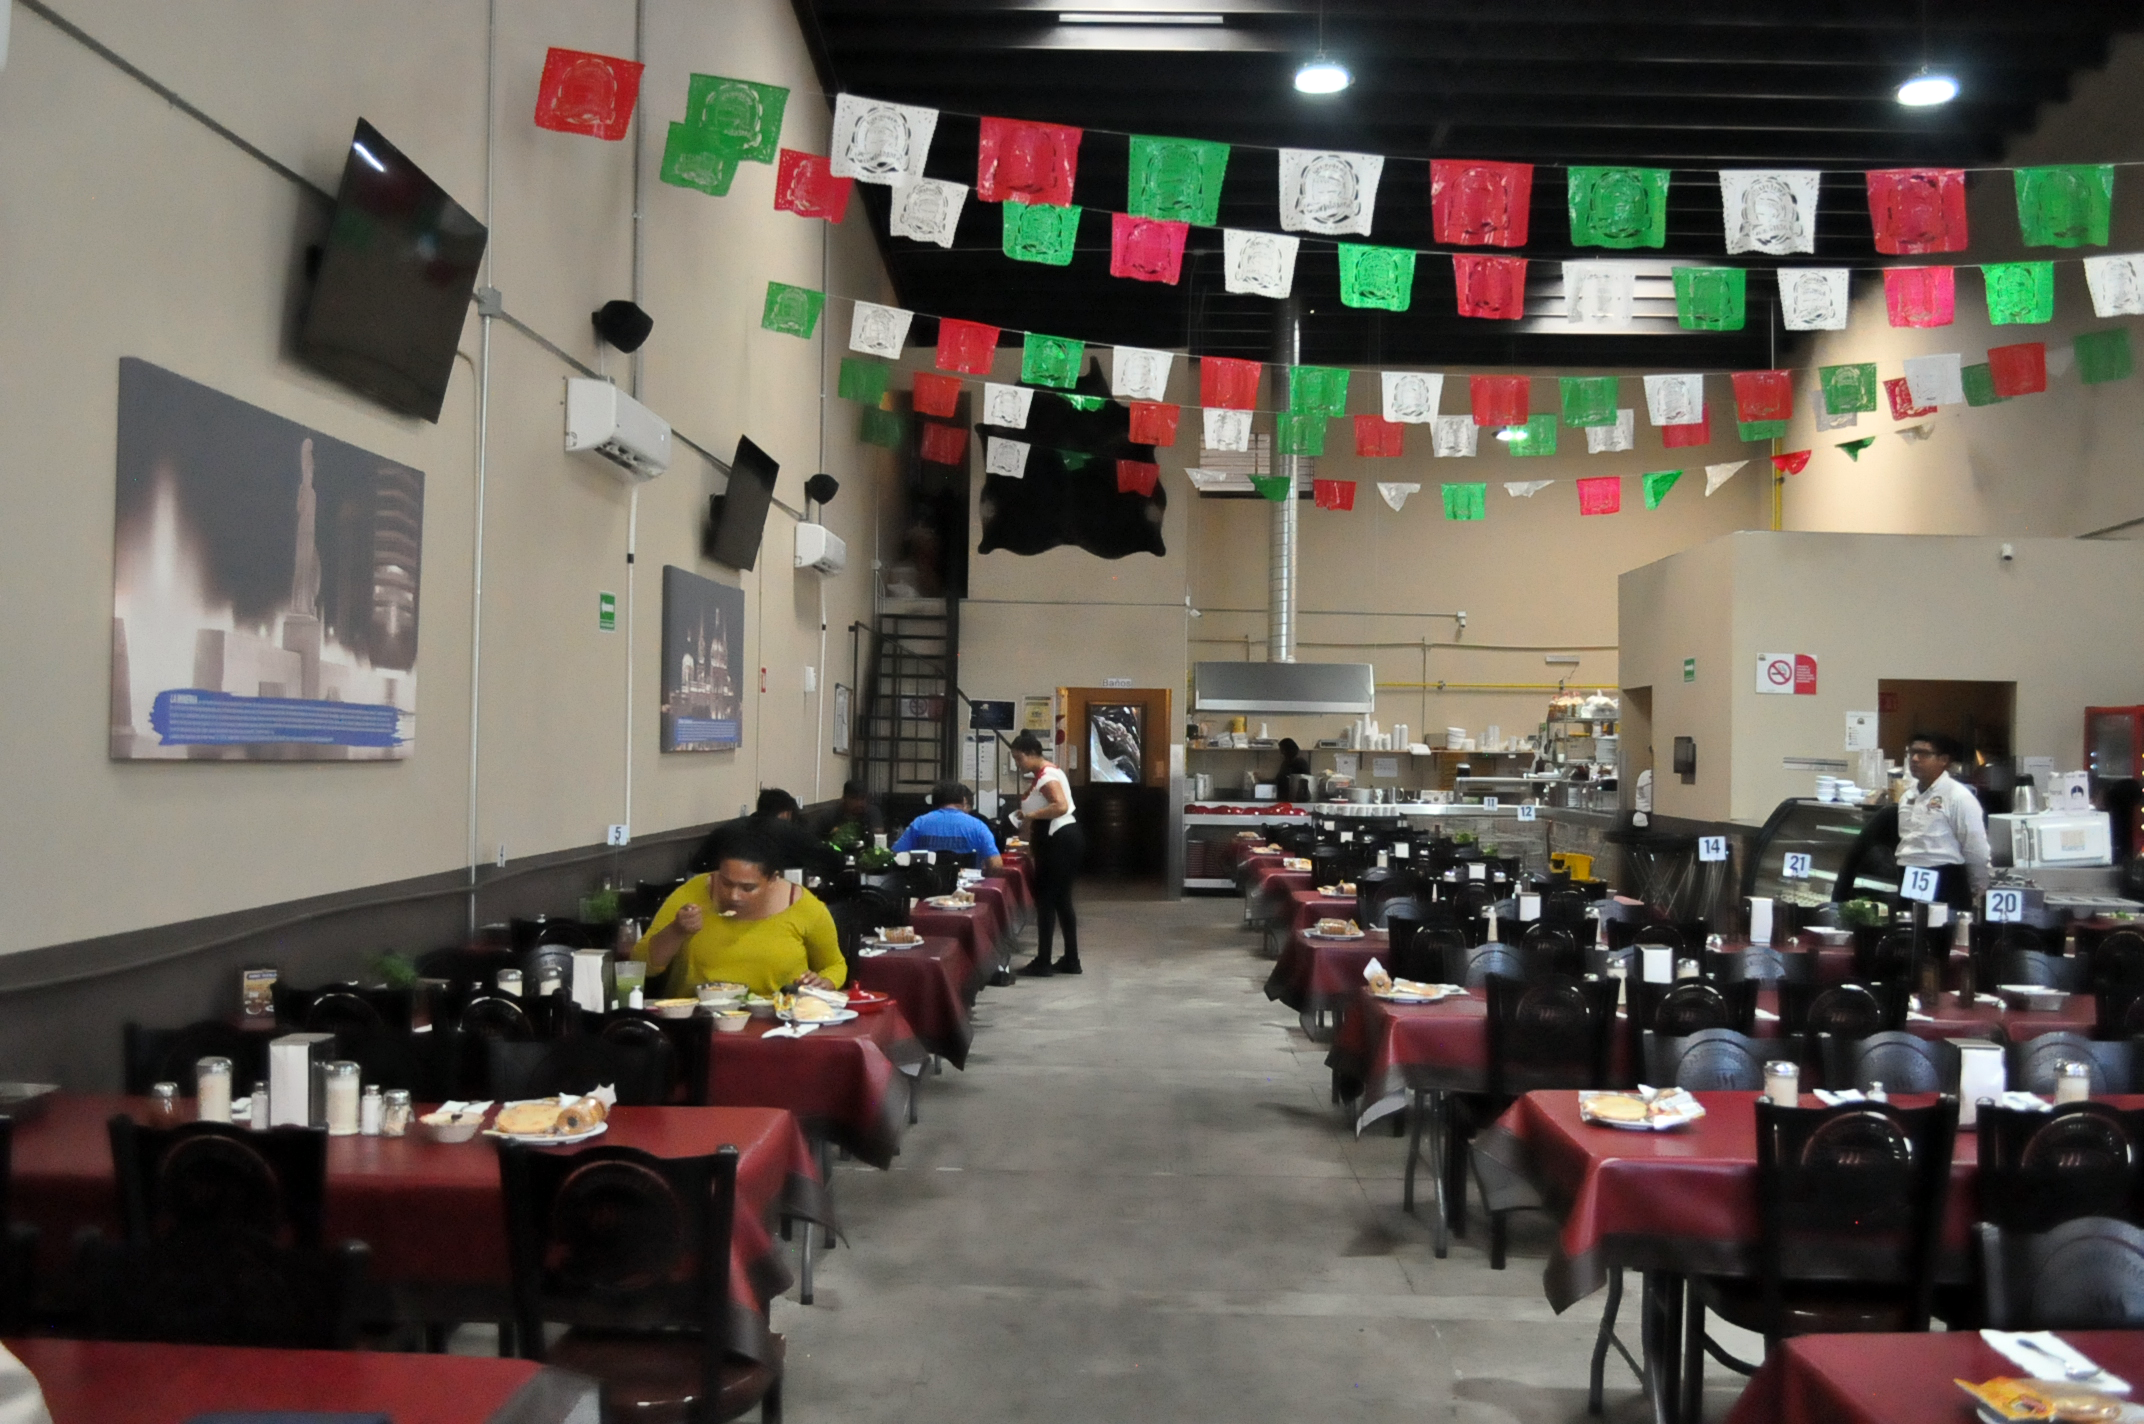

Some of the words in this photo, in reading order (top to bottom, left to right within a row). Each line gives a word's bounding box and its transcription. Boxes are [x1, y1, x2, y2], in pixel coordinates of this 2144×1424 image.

[1486, 798, 1495, 807] 11
[1520, 806, 1532, 817] 12
[614, 826, 622, 841] 5
[1704, 839, 1720, 854] 14
[1789, 855, 1806, 872] 21
[1911, 870, 1931, 892] 15
[1991, 893, 2017, 913] 20
